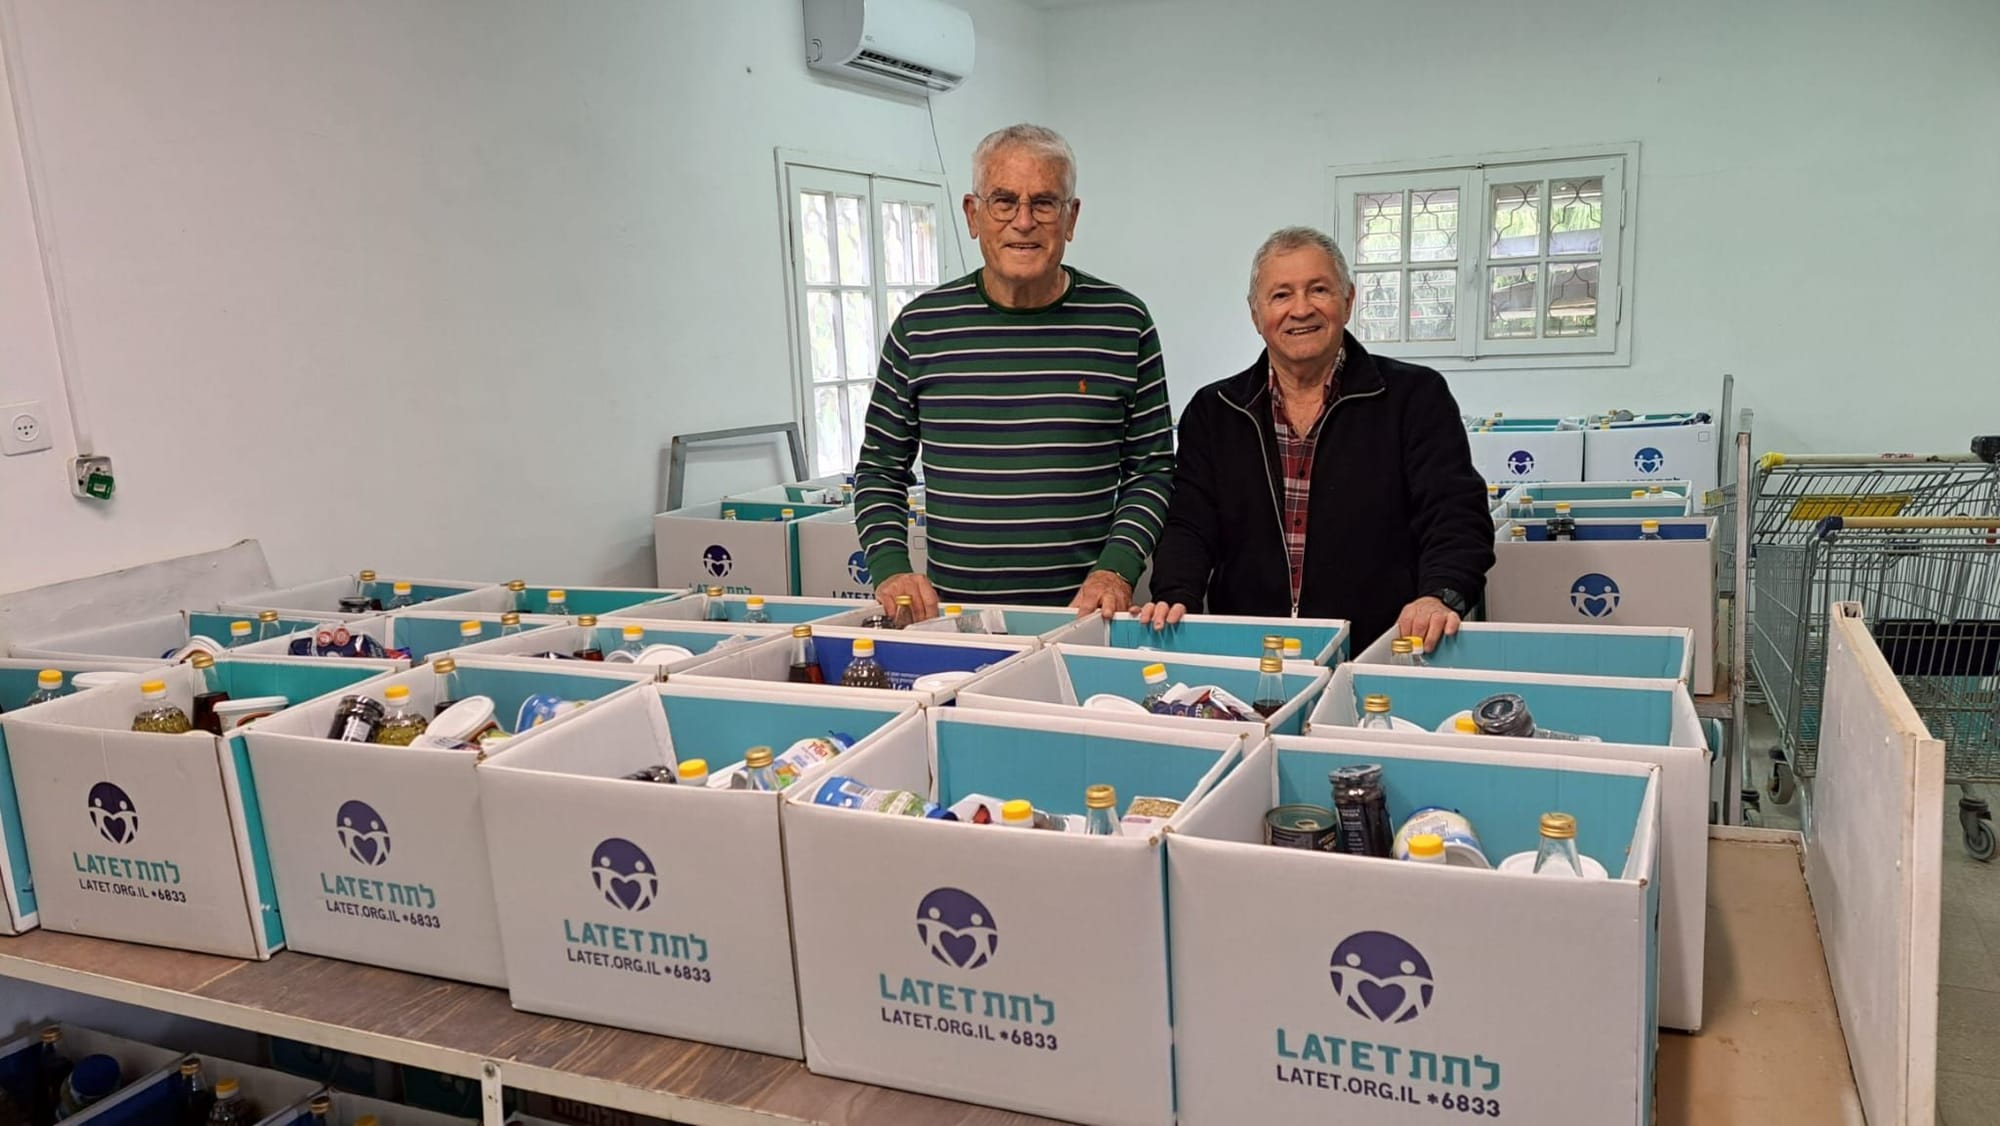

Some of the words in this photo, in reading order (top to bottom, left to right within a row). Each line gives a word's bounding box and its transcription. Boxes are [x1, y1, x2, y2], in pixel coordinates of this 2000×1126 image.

[73, 851, 134, 880] LATET
[135, 858, 181, 885] לתת
[79, 878, 150, 899] LATET.ORG.IL
[320, 871, 386, 902] LATET
[387, 881, 436, 909] לתת
[325, 899, 401, 924] LATET.ORG.IL
[564, 918, 645, 952] LATET
[649, 931, 708, 962] לתת
[566, 947, 662, 976] LATET.ORG.IL
[879, 973, 978, 1016] LATET
[981, 991, 1056, 1027] לתת
[880, 1006, 997, 1042] LATET.ORG.IL
[1276, 1028, 1403, 1077] LATET
[1408, 1050, 1502, 1093] לתת
[1275, 1063, 1423, 1106] LATET.ORG.IL
